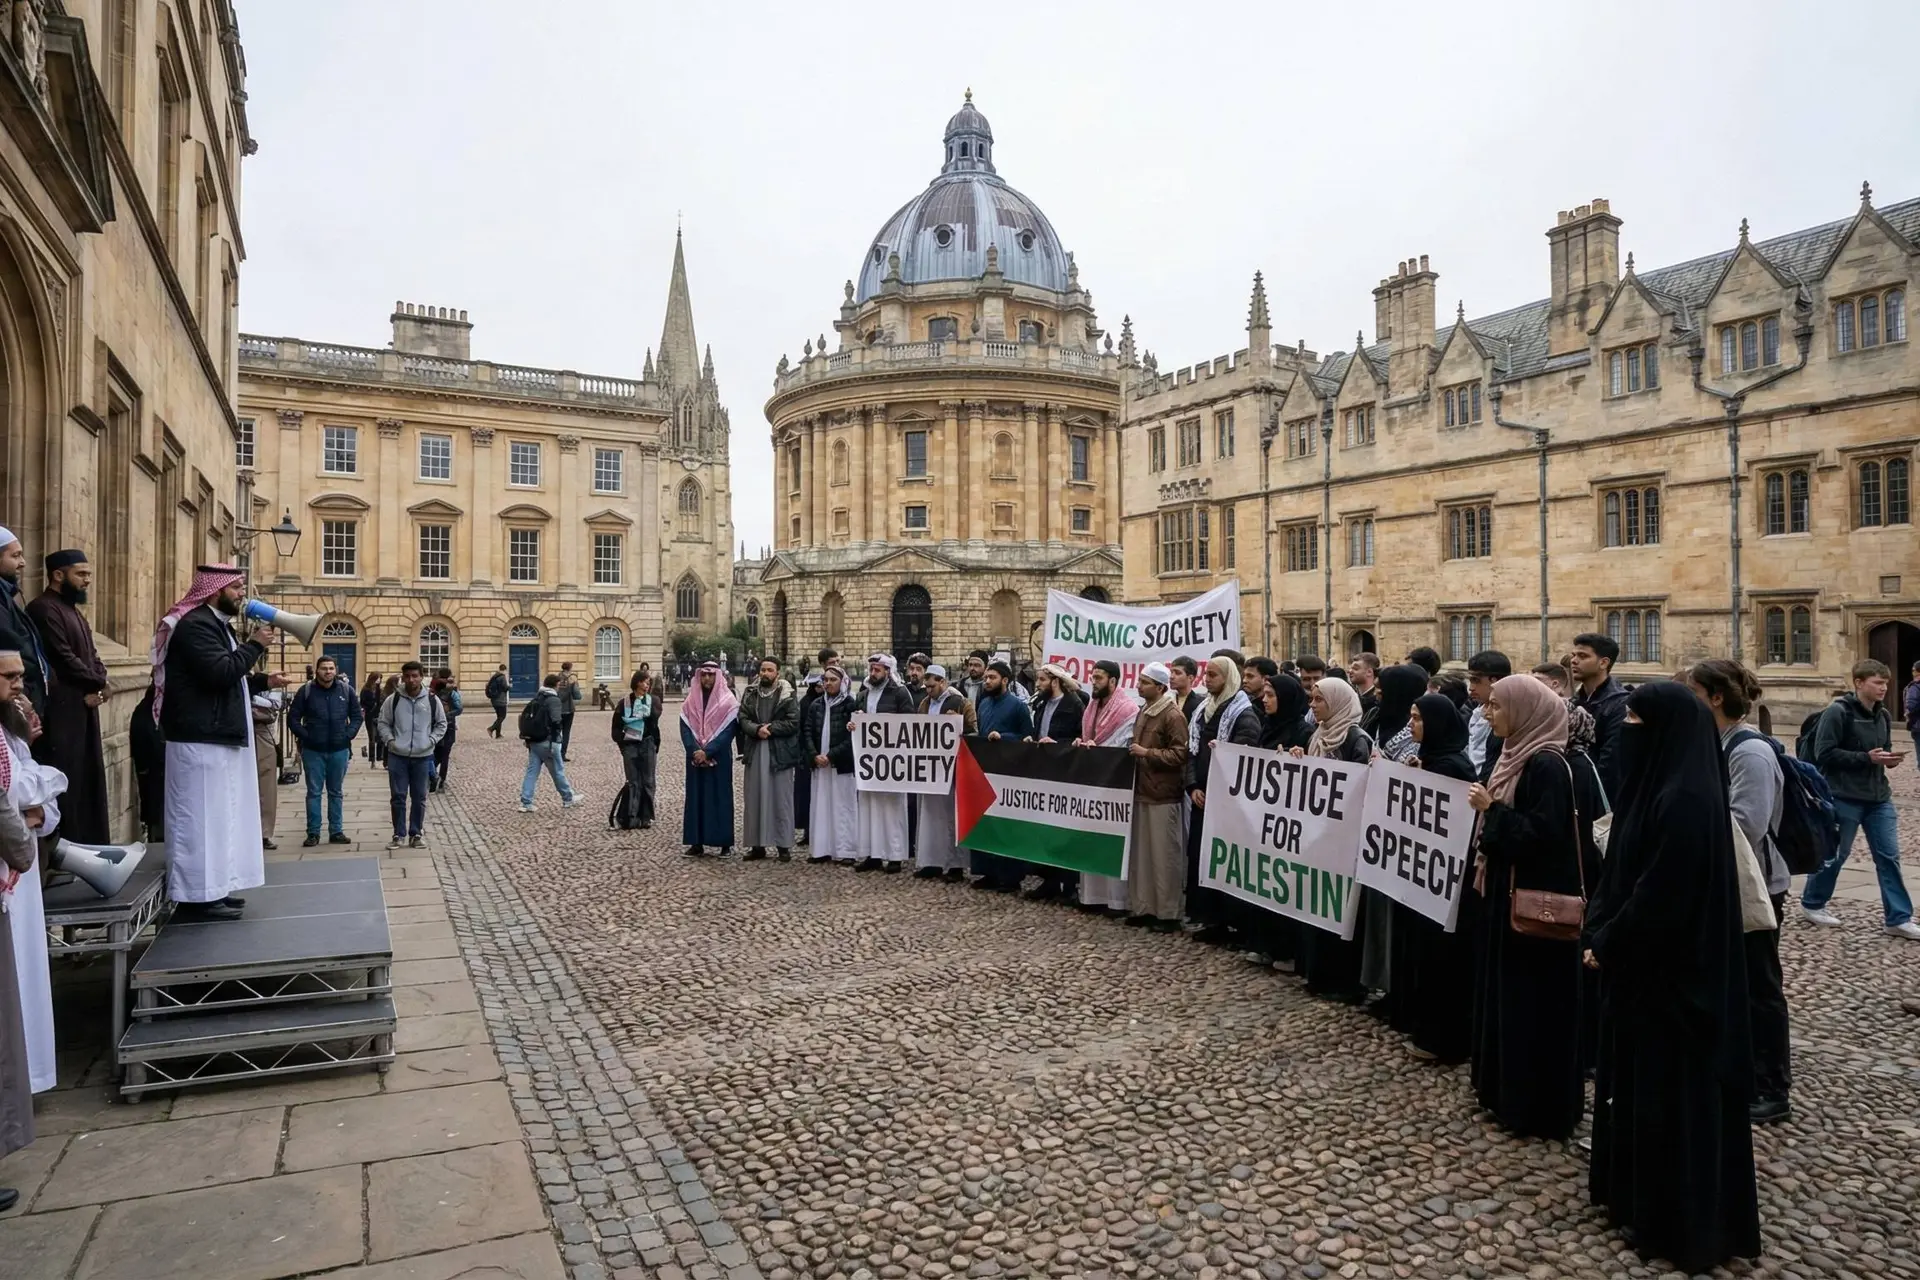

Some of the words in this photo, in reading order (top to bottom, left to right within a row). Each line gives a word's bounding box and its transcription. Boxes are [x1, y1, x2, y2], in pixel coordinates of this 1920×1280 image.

[1054, 613, 1138, 649] ISLAMIC
[1142, 609, 1232, 649] SOCIETY
[861, 721, 955, 750] ISLAMIC
[859, 754, 955, 783] SOCIETY
[1229, 755, 1347, 821] JUSTICE
[999, 788, 1045, 811] JUSTICE
[1048, 794, 1068, 815] FOR
[1386, 777, 1451, 838] FREE
[1261, 813, 1302, 854] FOR
[1362, 823, 1465, 901] SPEECH
